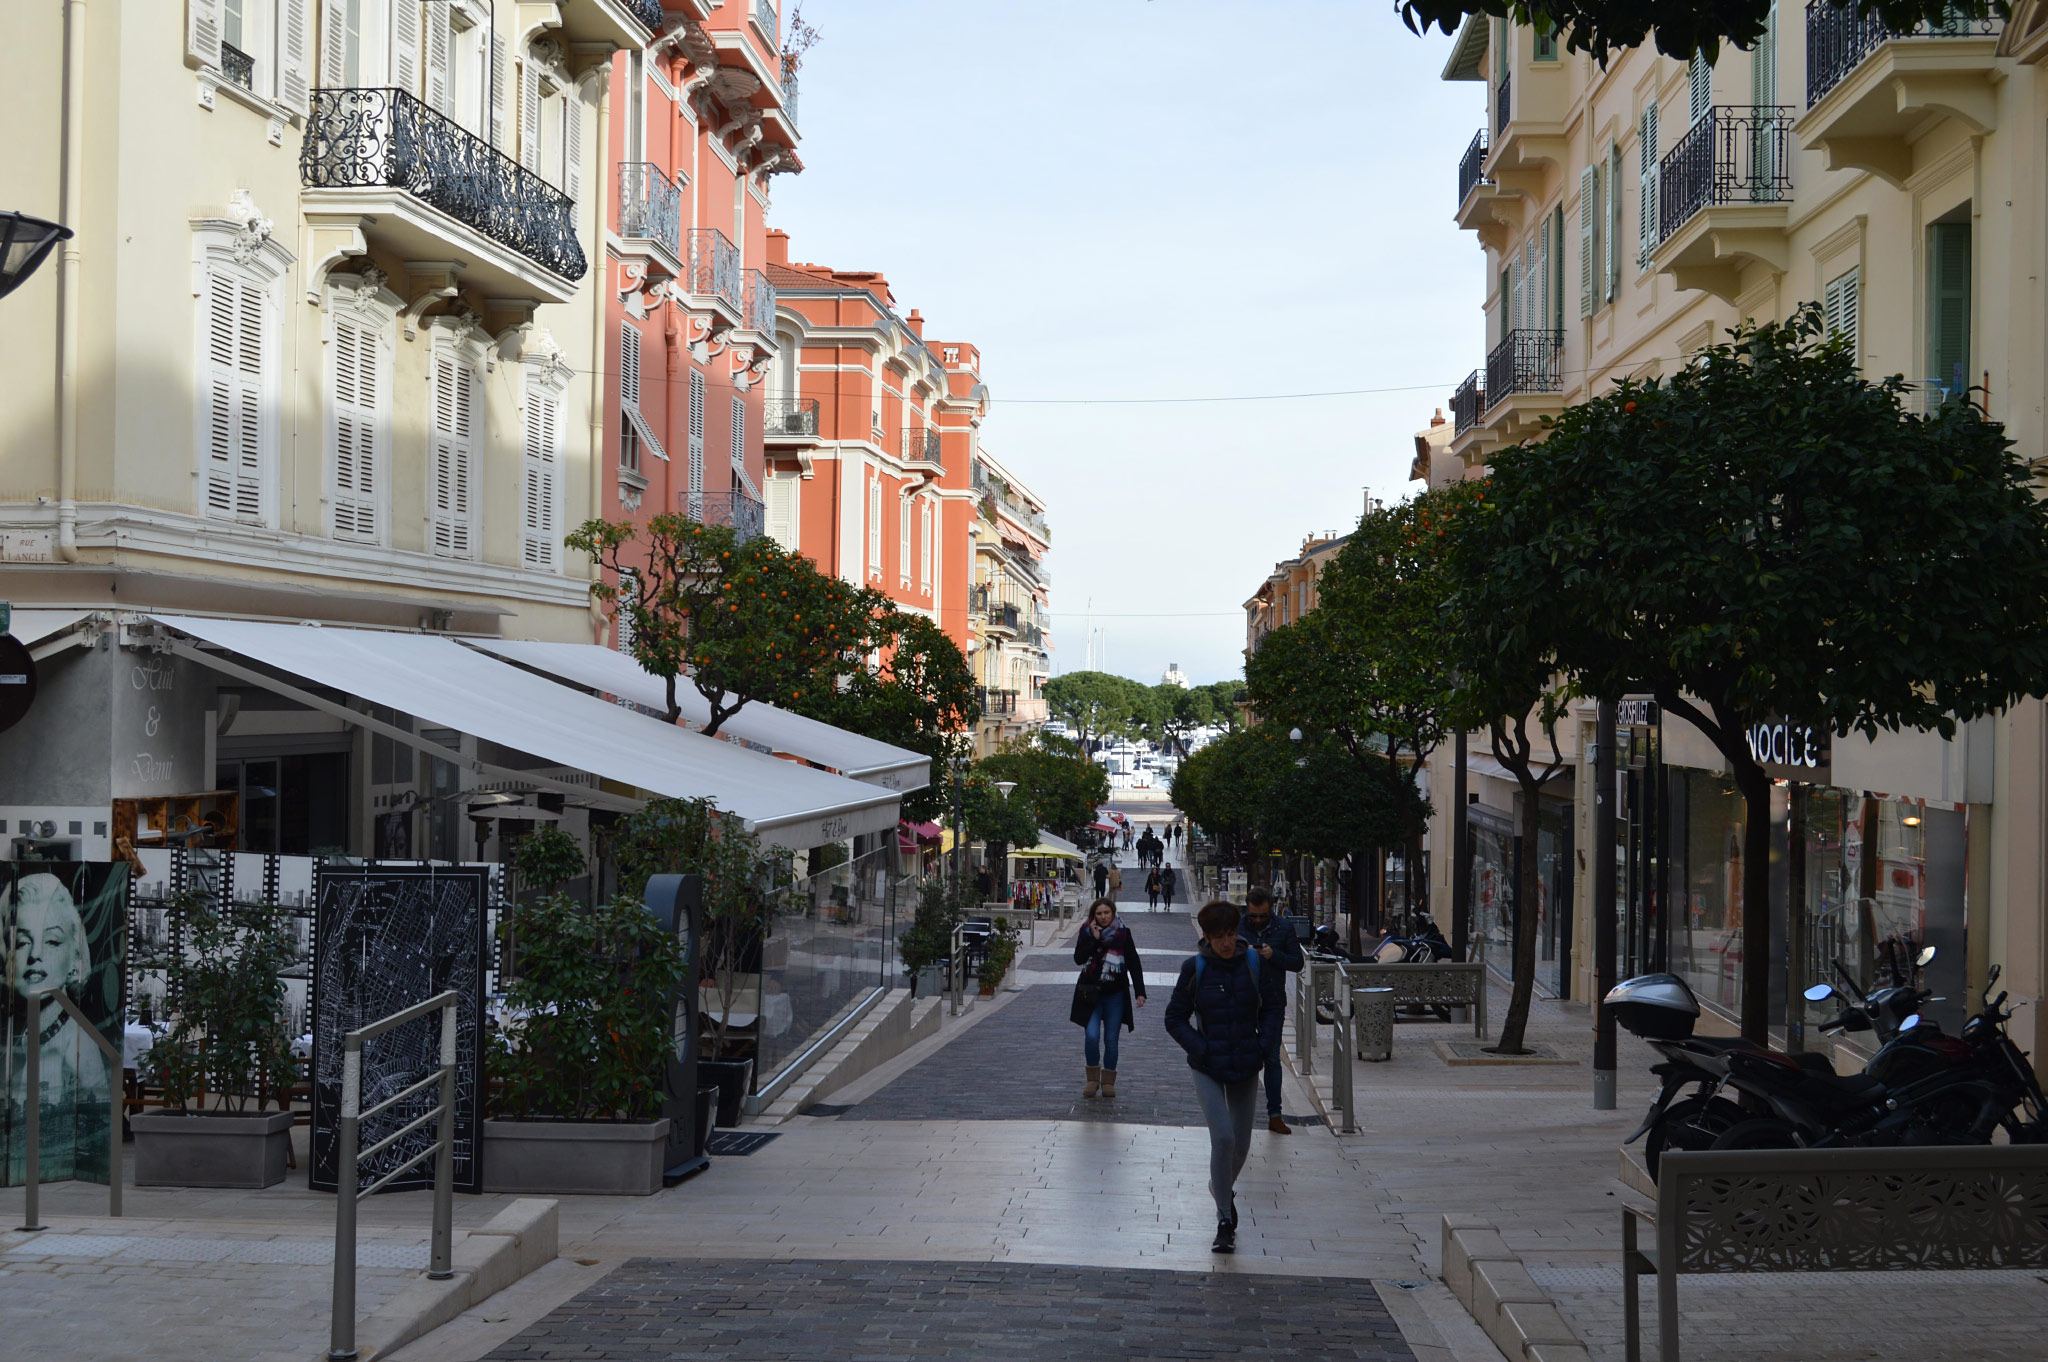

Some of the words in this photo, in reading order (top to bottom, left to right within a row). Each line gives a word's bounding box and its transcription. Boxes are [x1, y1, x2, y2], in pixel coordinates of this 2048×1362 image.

[20, 539, 36, 547] RUE
[131, 657, 175, 690] Huit
[145, 705, 161, 737] &
[131, 752, 174, 782] Demi
